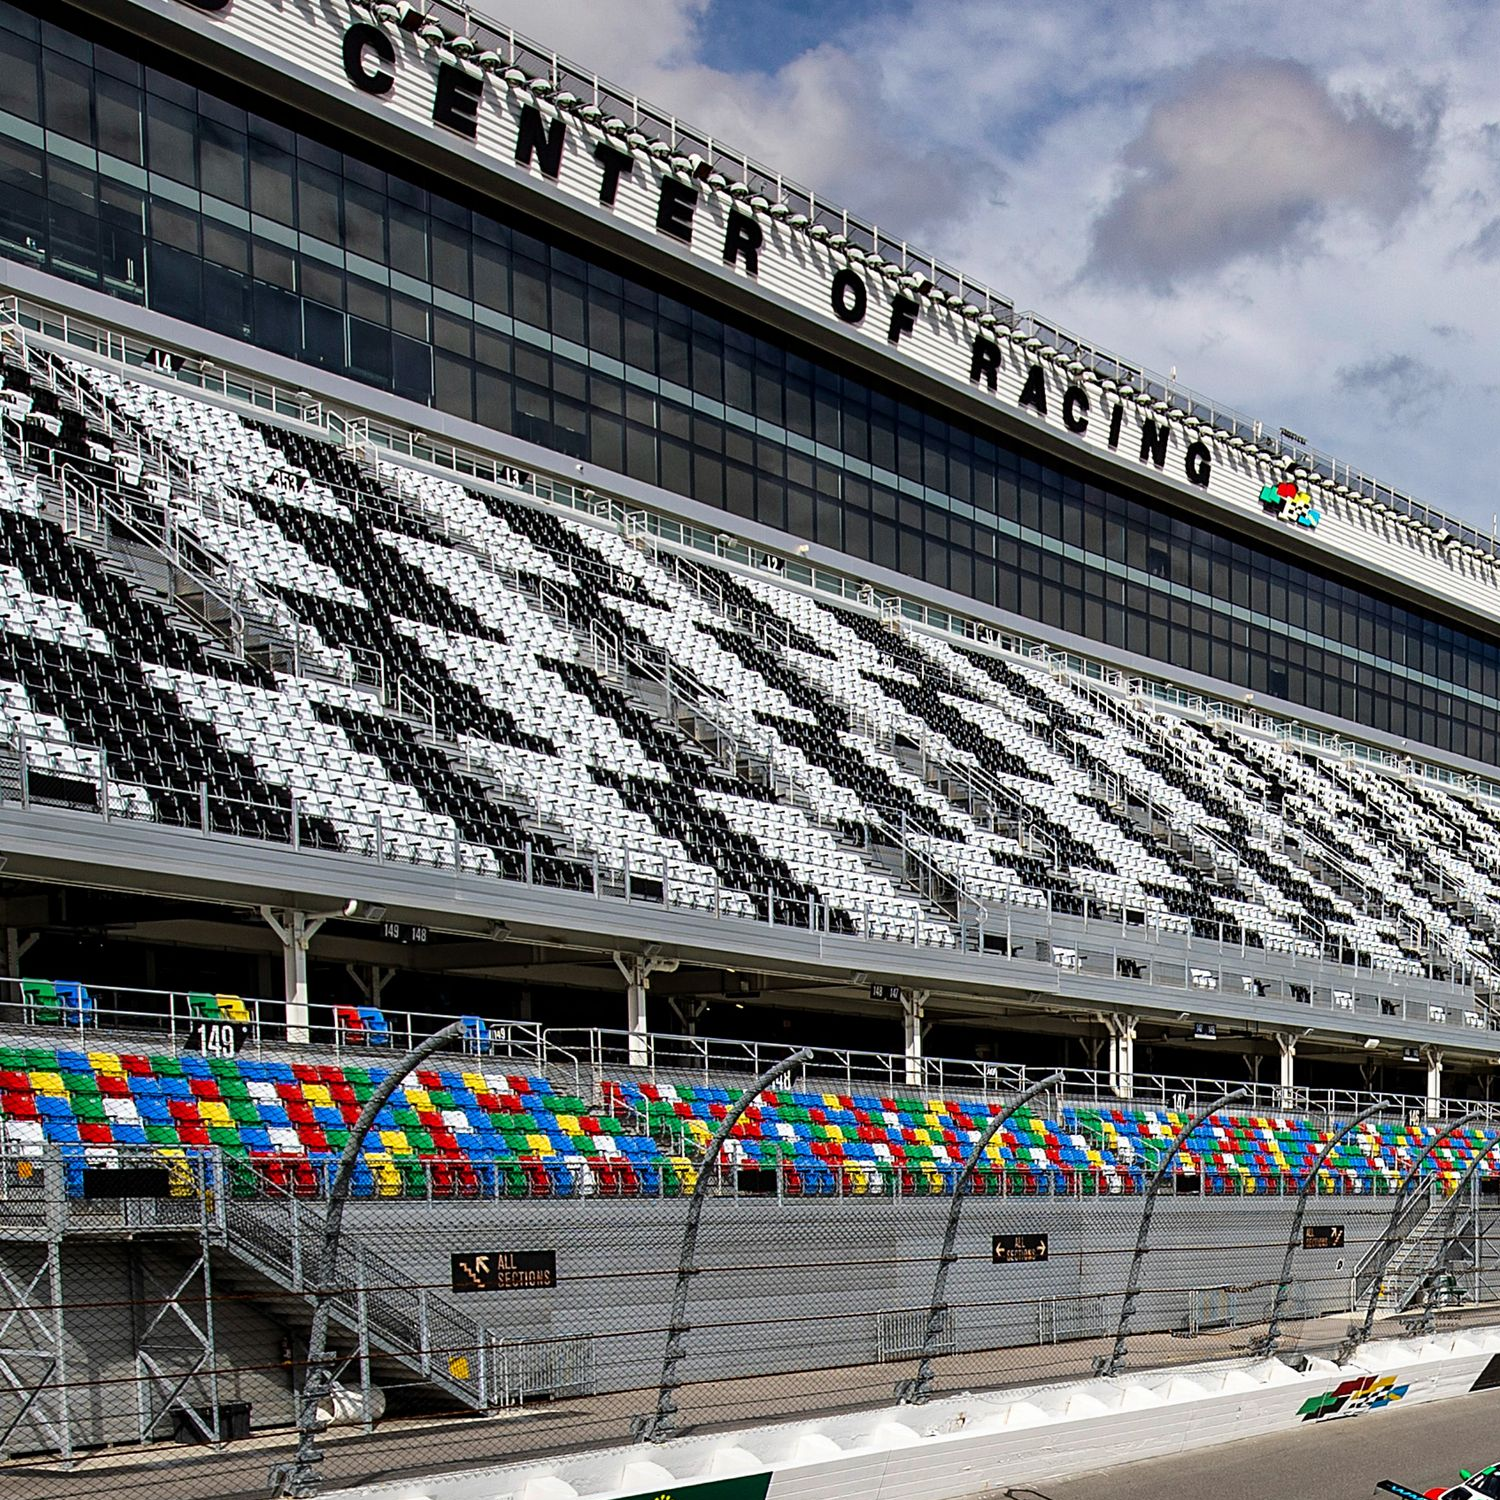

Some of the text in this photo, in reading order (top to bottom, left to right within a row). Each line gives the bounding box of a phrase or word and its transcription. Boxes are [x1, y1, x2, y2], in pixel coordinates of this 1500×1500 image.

[342, 22, 1213, 489] CENTER OF RACING
[273, 471, 299, 491] 353
[197, 1025, 235, 1058] 149
[496, 1252, 519, 1271] ALL
[497, 1265, 551, 1287] SECTIONS
